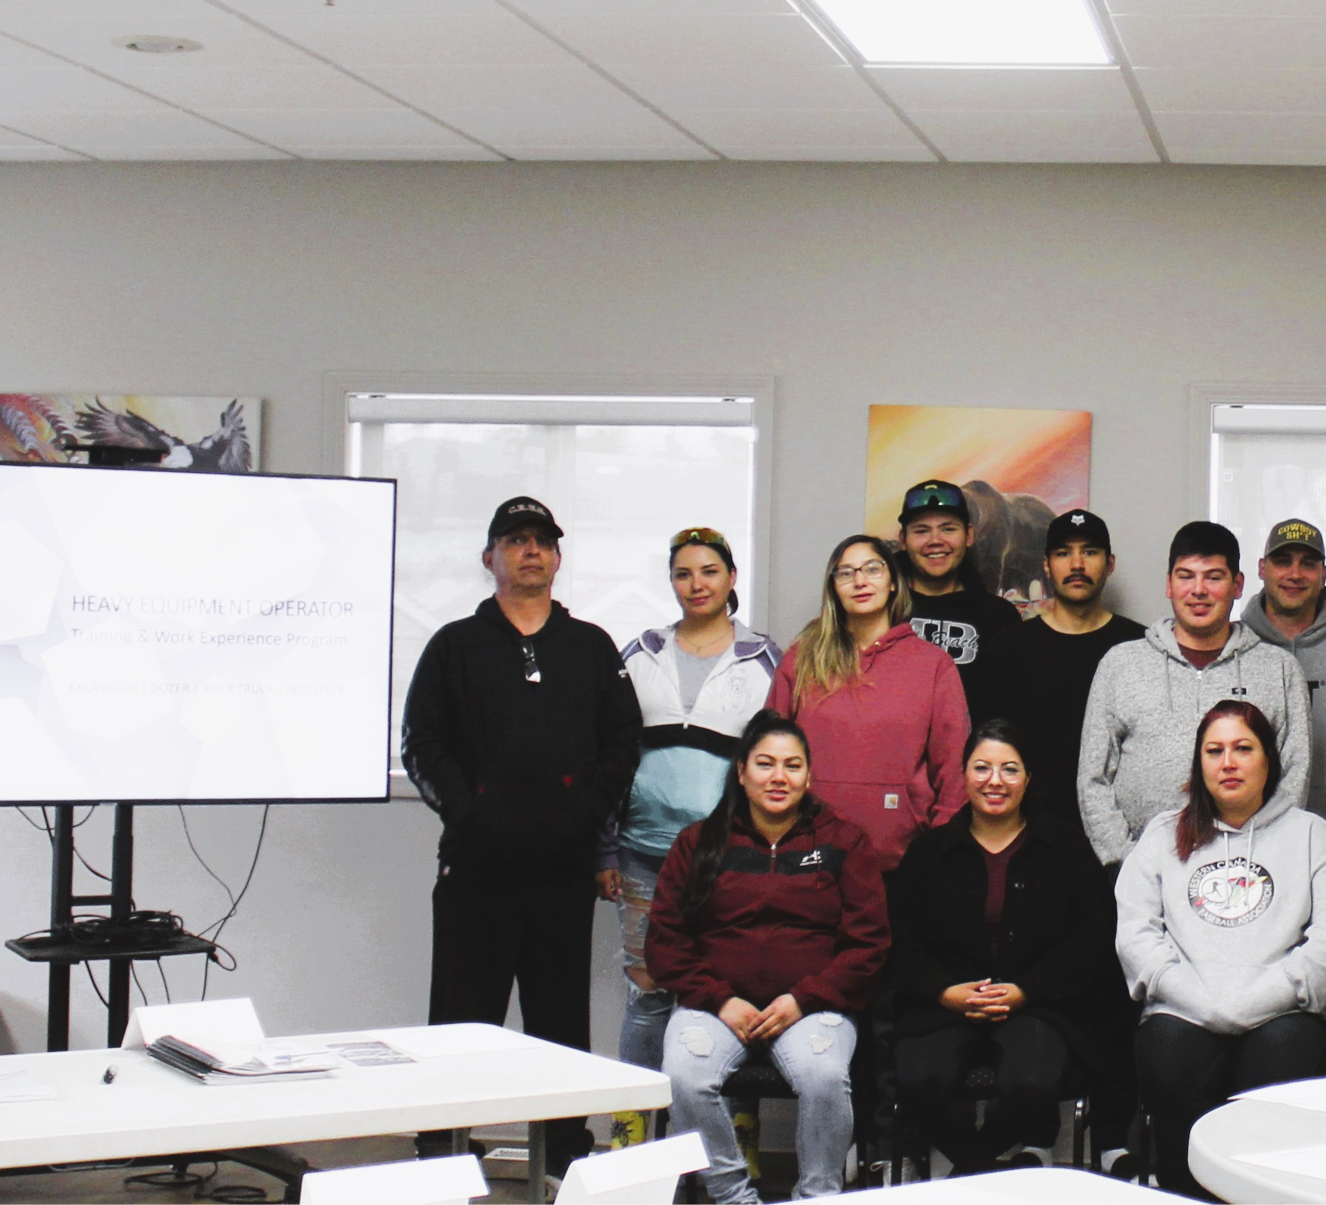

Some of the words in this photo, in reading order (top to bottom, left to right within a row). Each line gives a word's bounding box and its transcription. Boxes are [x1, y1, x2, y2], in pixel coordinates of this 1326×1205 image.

[72, 595, 134, 613] HEAVY
[140, 596, 254, 616] EQUIPMENT
[260, 599, 354, 618] OPERATOR
[70, 628, 132, 646] Training
[137, 629, 149, 643] &
[154, 630, 195, 644] Work
[200, 631, 282, 648] Experience
[286, 633, 348, 649] Program
[69, 682, 137, 693] EXCAVATOR
[150, 683, 190, 694] DOZER
[202, 684, 233, 695] ROCK
[237, 684, 274, 695] TRUCK
[286, 684, 345, 696] SKIDSTEER
[1189, 864, 1216, 899] WESTERN
[1216, 857, 1262, 875] CANADA
[1198, 908, 1236, 927] BASEBALL
[1237, 883, 1272, 925] ASSOCIATION
